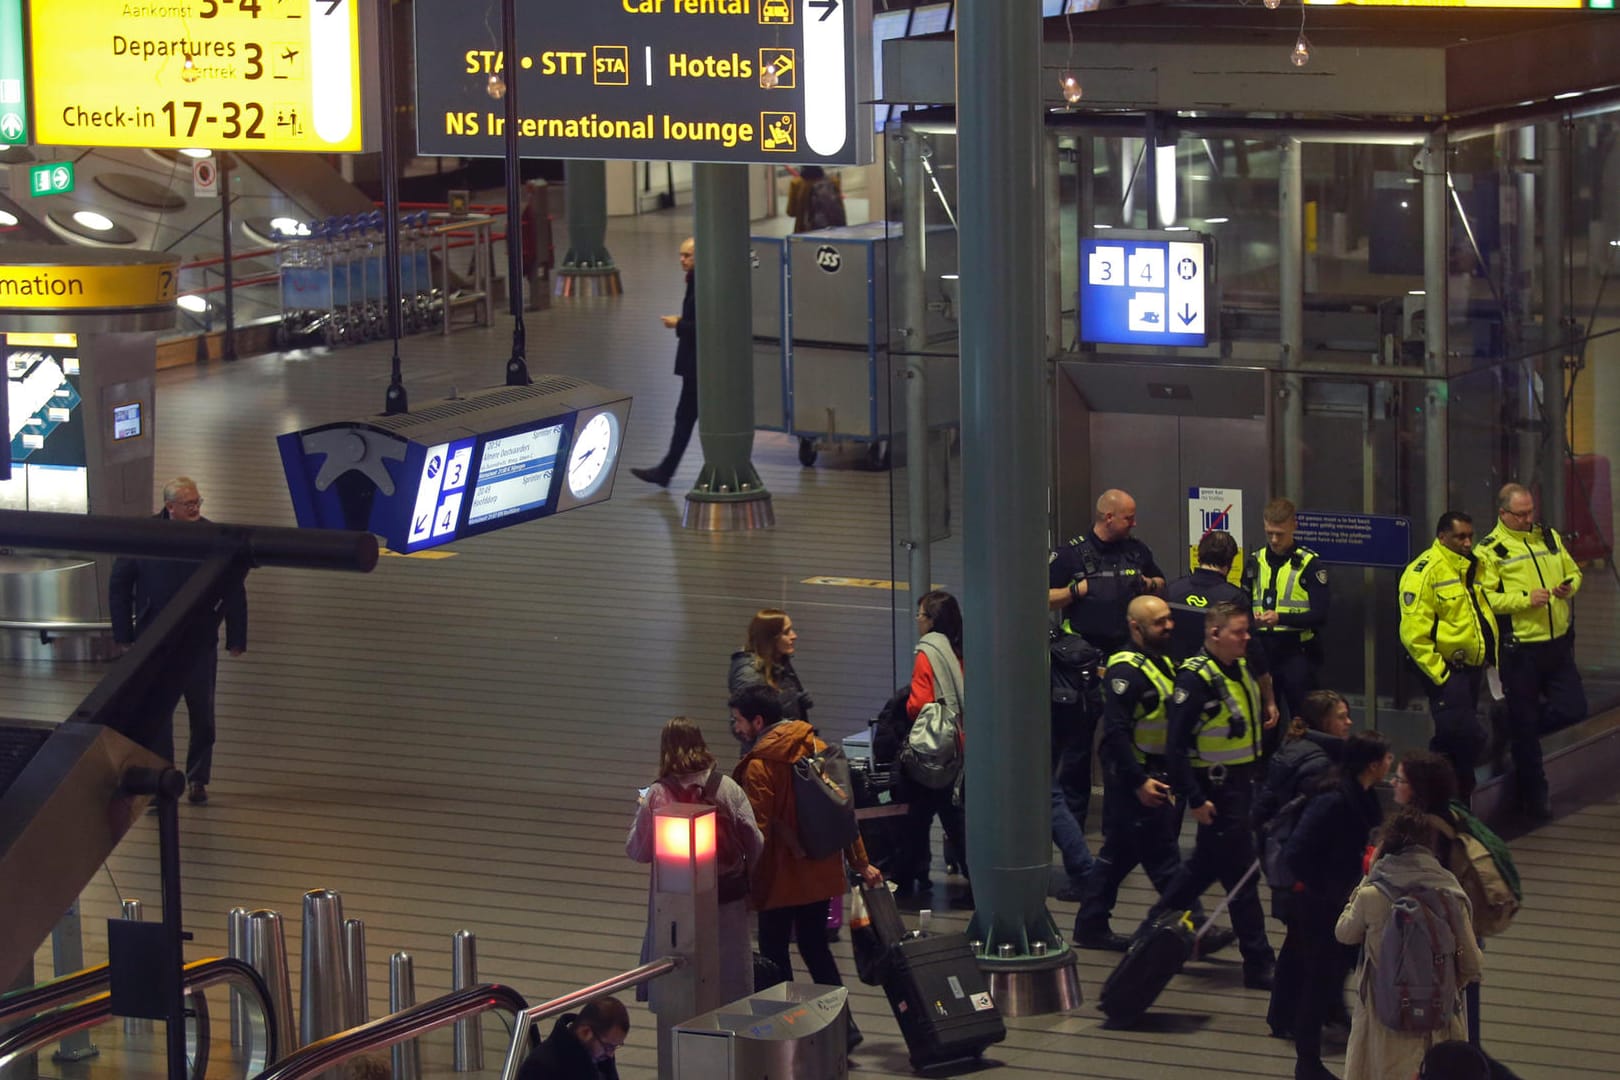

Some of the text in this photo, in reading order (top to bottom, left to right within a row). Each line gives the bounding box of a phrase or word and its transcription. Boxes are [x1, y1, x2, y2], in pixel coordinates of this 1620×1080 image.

[113, 35, 236, 61] Departures
[244, 43, 264, 80] 3
[541, 52, 587, 75] STT
[596, 58, 626, 73] STA
[669, 53, 753, 78] Hotels
[63, 101, 265, 139] Check-in 17-32
[445, 112, 754, 147] NS Inernational lounge
[817, 251, 840, 267] ISS
[1101, 261, 1153, 282] 3 4
[0, 273, 83, 295] mation
[451, 464, 462, 485] 3
[441, 510, 452, 531] 4
